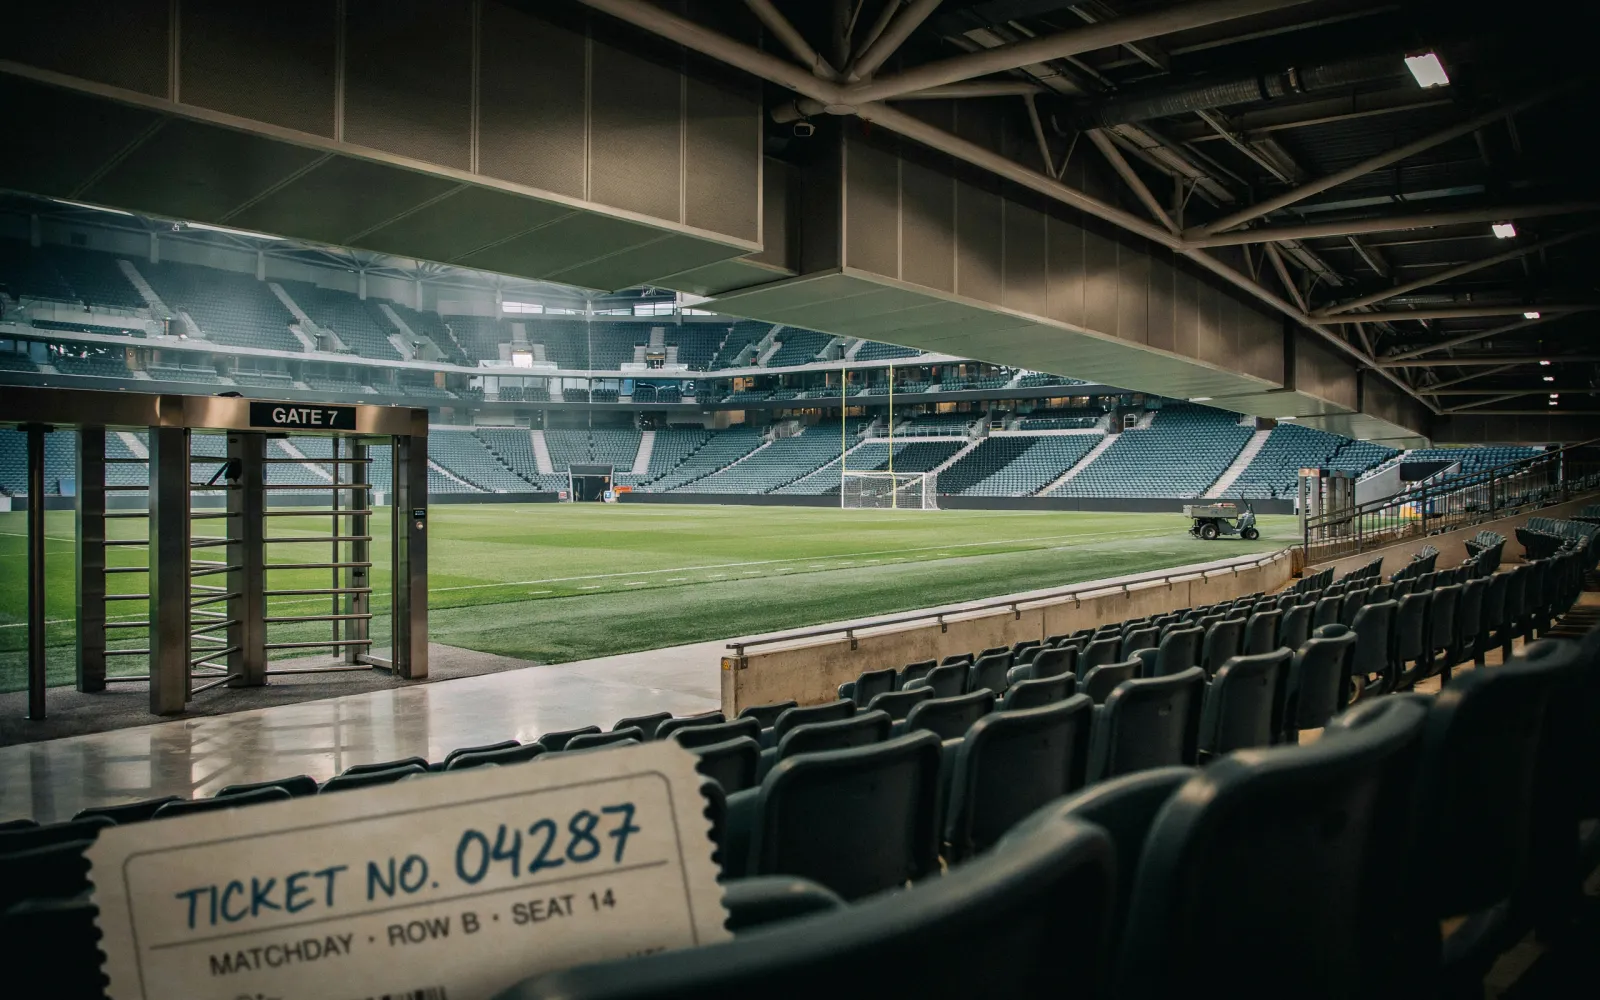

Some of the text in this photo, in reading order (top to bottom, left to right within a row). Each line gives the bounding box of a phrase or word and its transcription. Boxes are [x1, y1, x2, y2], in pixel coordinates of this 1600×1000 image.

[272, 407, 338, 426] GATE 7
[175, 802, 641, 929] TICKET NO. 04287
[209, 888, 617, 976] MATCHDAY ROW B SEAT 14
